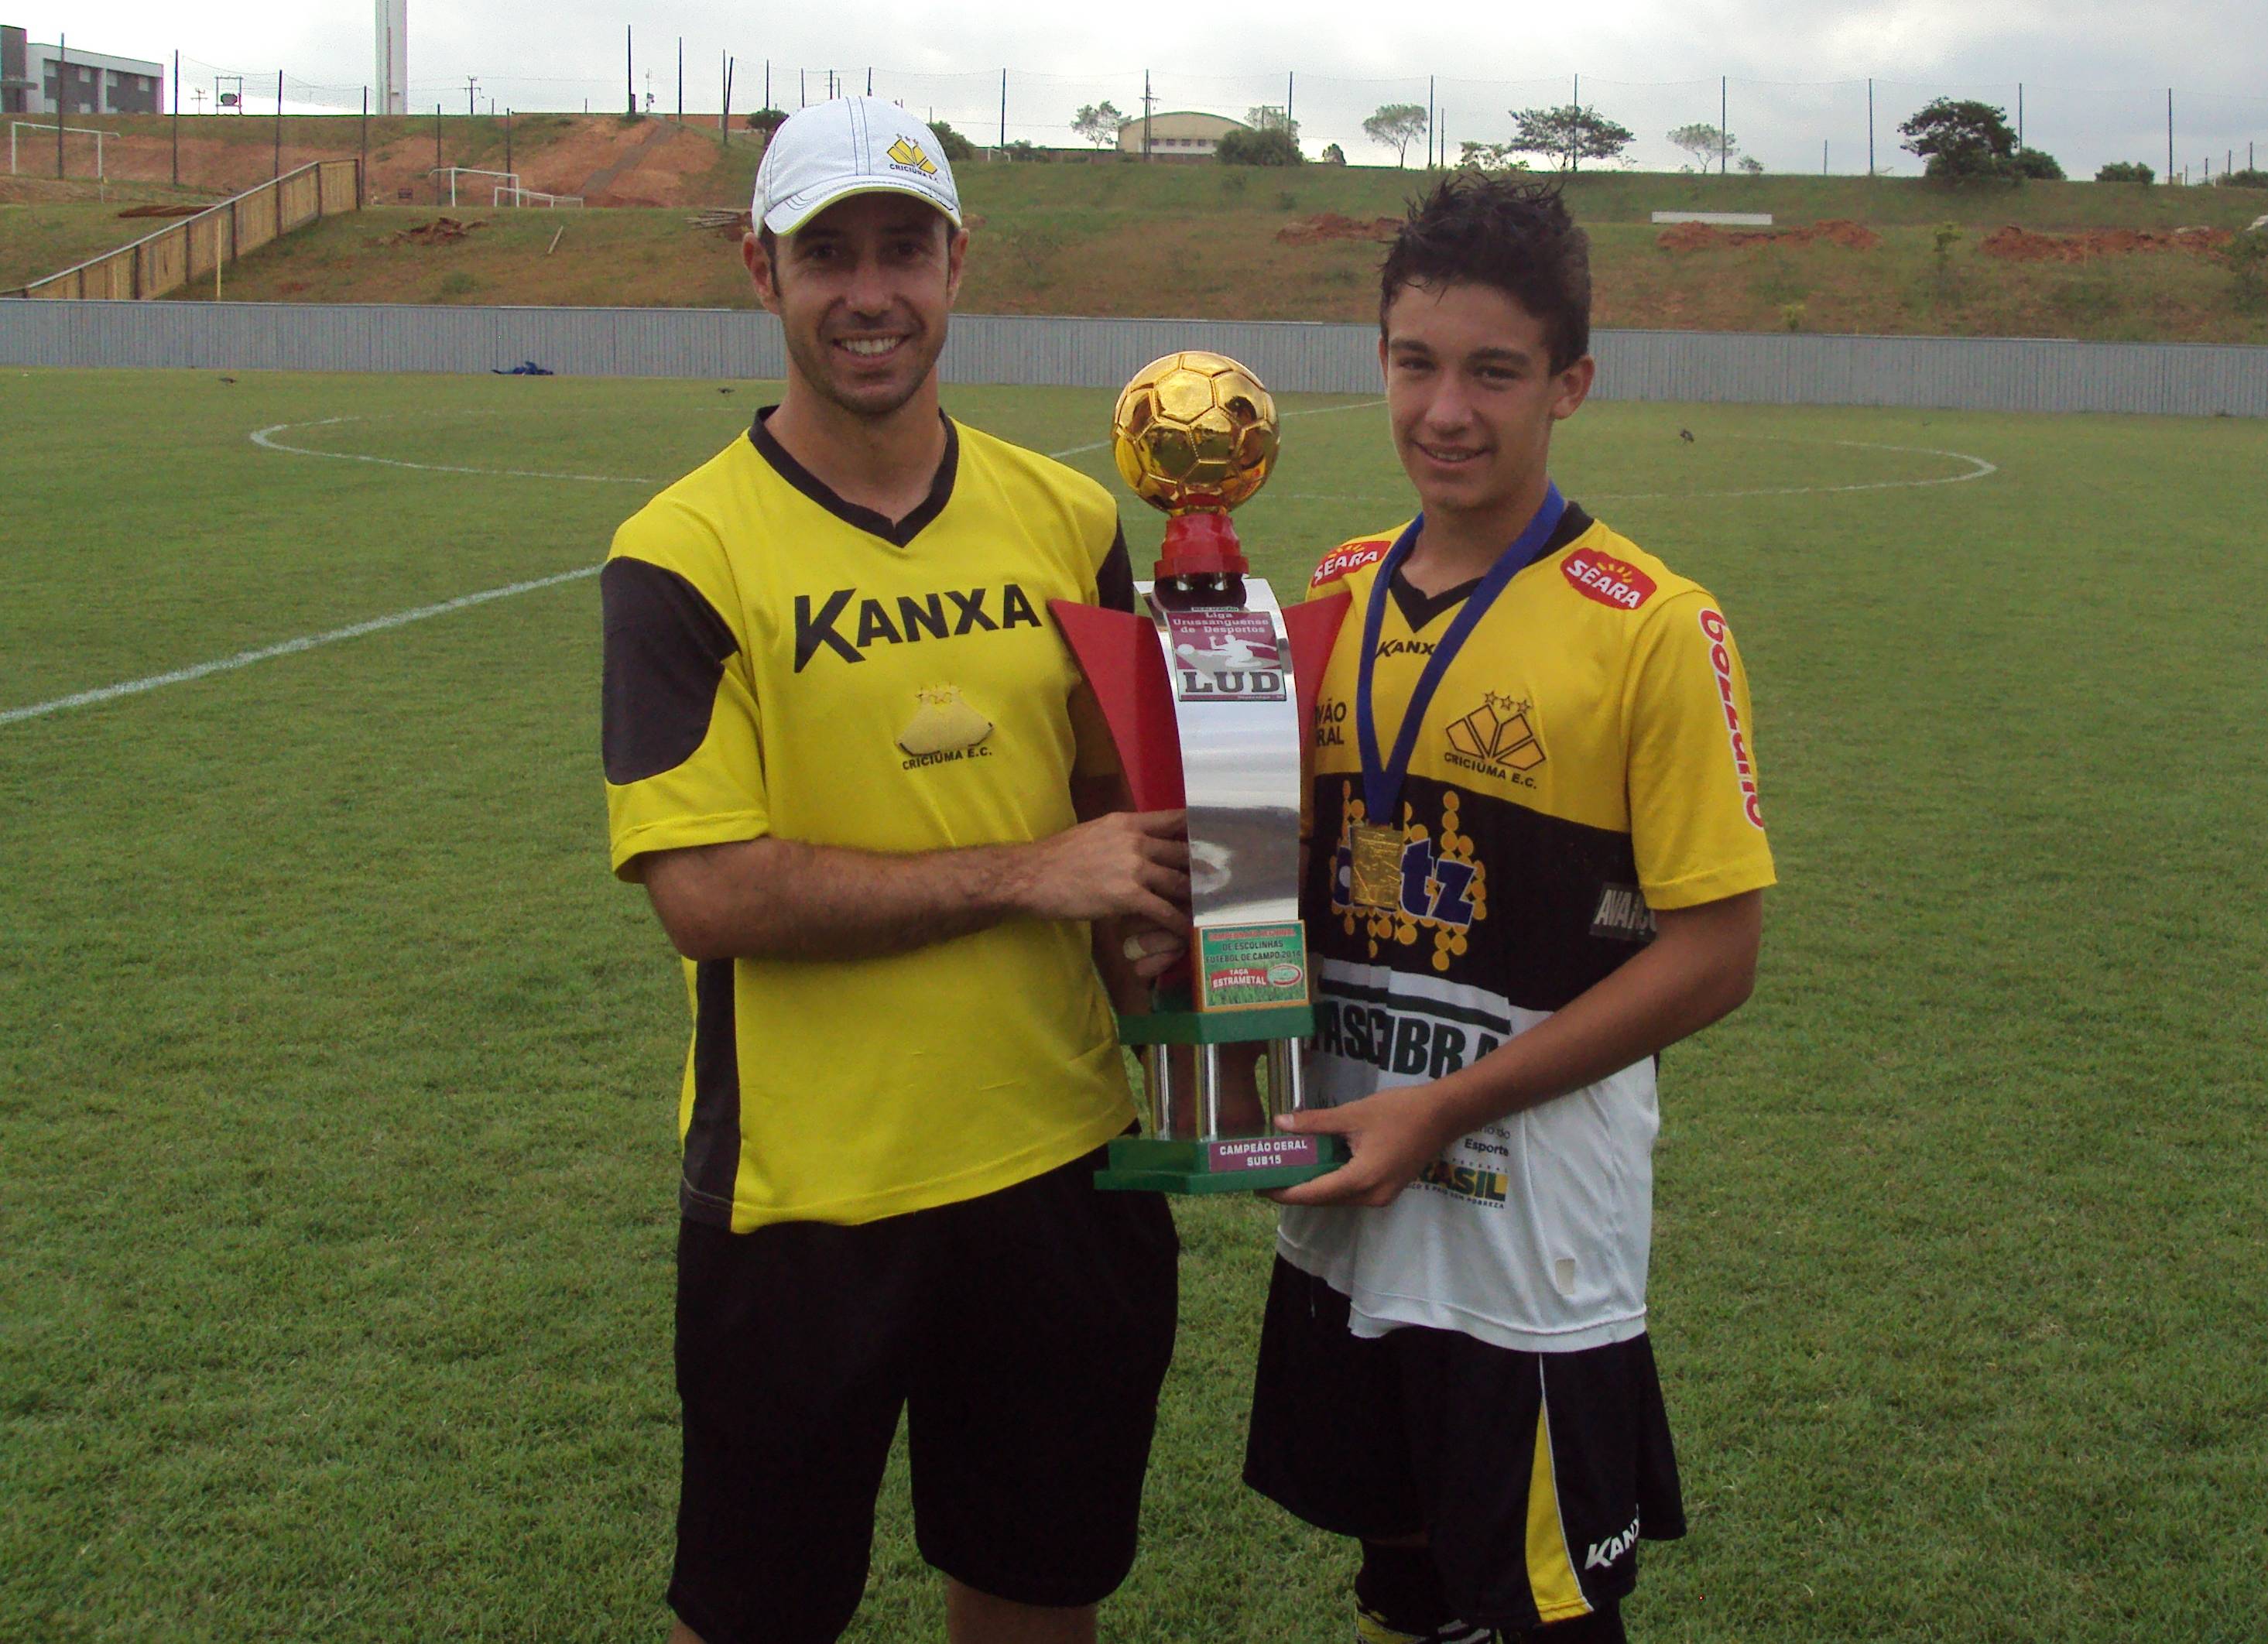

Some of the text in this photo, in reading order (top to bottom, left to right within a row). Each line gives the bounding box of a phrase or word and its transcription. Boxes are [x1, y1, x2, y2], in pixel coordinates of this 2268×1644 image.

[1314, 550, 1378, 584] SEARA
[1566, 560, 1641, 608] SEARA
[793, 584, 1043, 673] KANXA
[1204, 626, 1266, 635] Desportos
[1375, 639, 1437, 659] KANX
[1183, 671, 1280, 693] LUD
[1314, 725, 1345, 748] RAL
[968, 746, 992, 759] E.C.
[1444, 752, 1537, 789] CRICIUMA E.C.
[1222, 940, 1283, 951] DE ESCOLINHAS
[1206, 954, 1238, 963] FUTEBOL
[1252, 951, 1280, 961] CAMPO
[1220, 1139, 1307, 1156] CAMPEÃO GERAL
[1465, 1138, 1509, 1156] Esporte
[1247, 1155, 1282, 1166] SUB15
[1585, 1517, 1639, 1570] KAN
